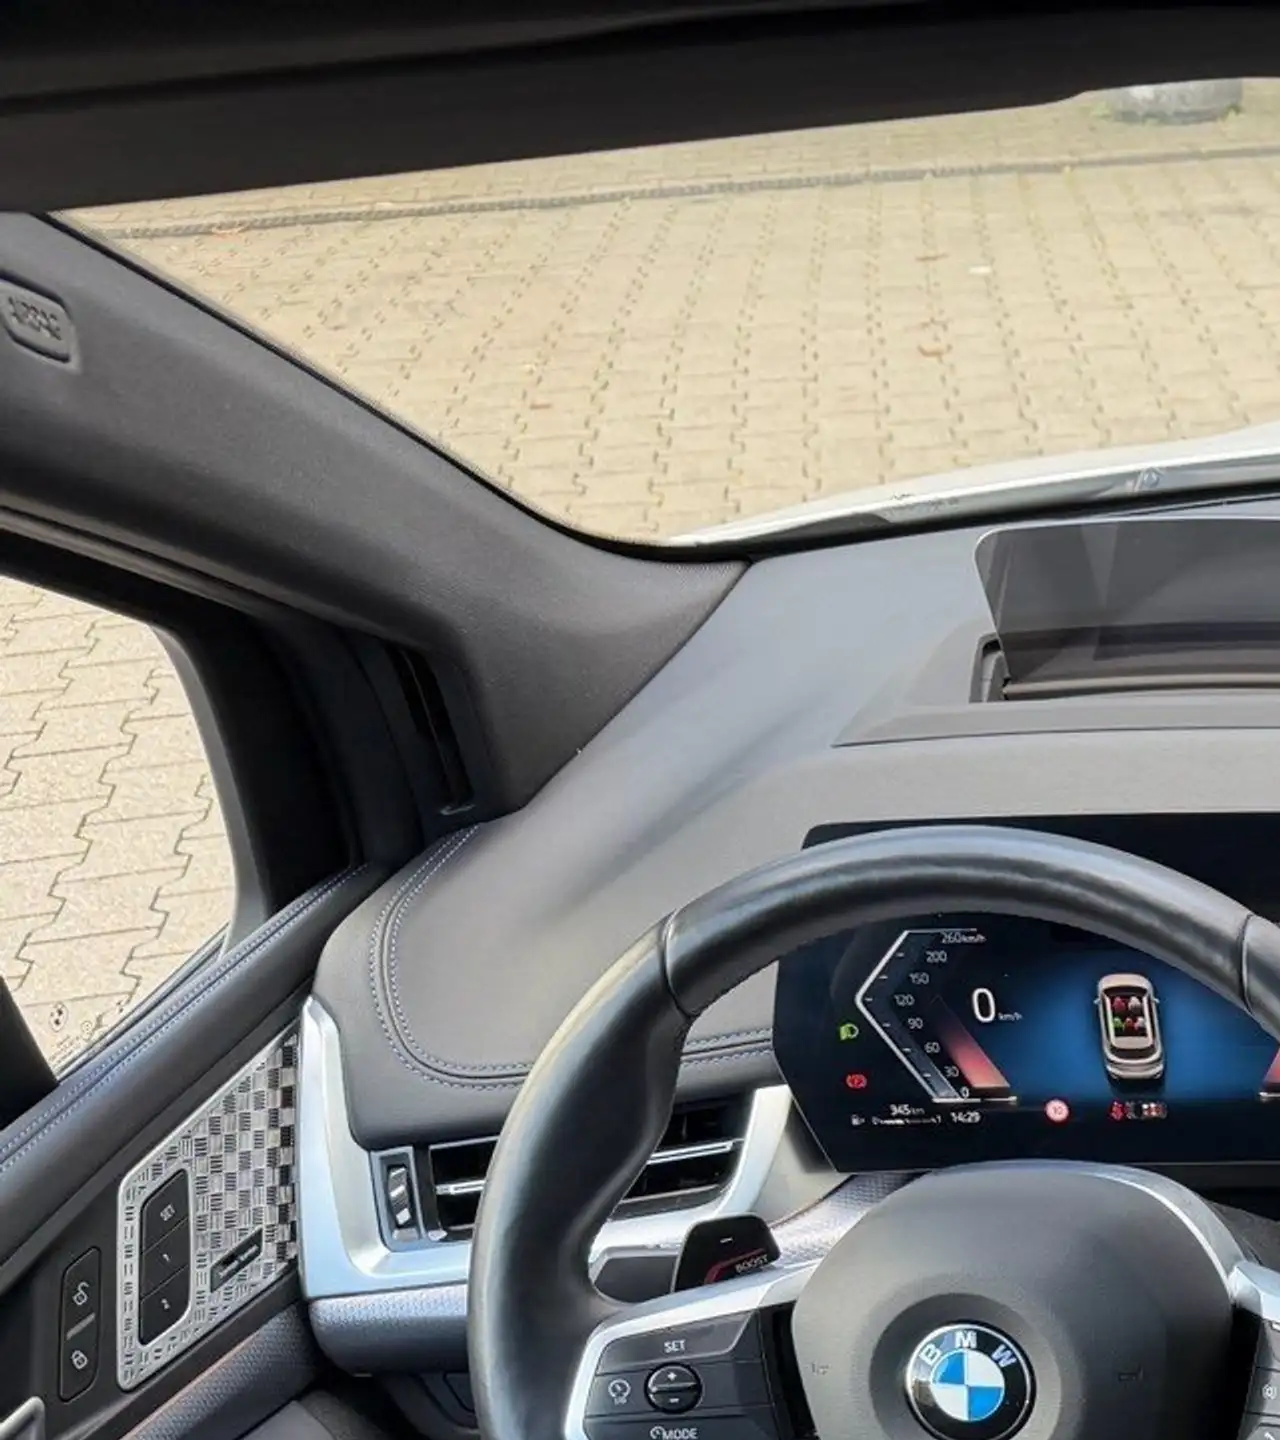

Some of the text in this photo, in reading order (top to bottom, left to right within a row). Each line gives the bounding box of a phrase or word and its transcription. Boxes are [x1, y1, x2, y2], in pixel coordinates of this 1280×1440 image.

[925, 950, 948, 963] 200
[908, 971, 930, 985] 150
[894, 993, 915, 1007] 120
[972, 987, 996, 1024] 0
[907, 1017, 924, 1030] 90
[924, 1041, 941, 1054] 60
[943, 1065, 960, 1079] 30
[960, 1085, 970, 1099] 0
[950, 1110, 981, 1124] 14:29
[735, 1253, 768, 1274] BOOST
[663, 1339, 686, 1354] SET
[919, 1330, 1017, 1368] BMW
[662, 1427, 699, 1440] MODE
